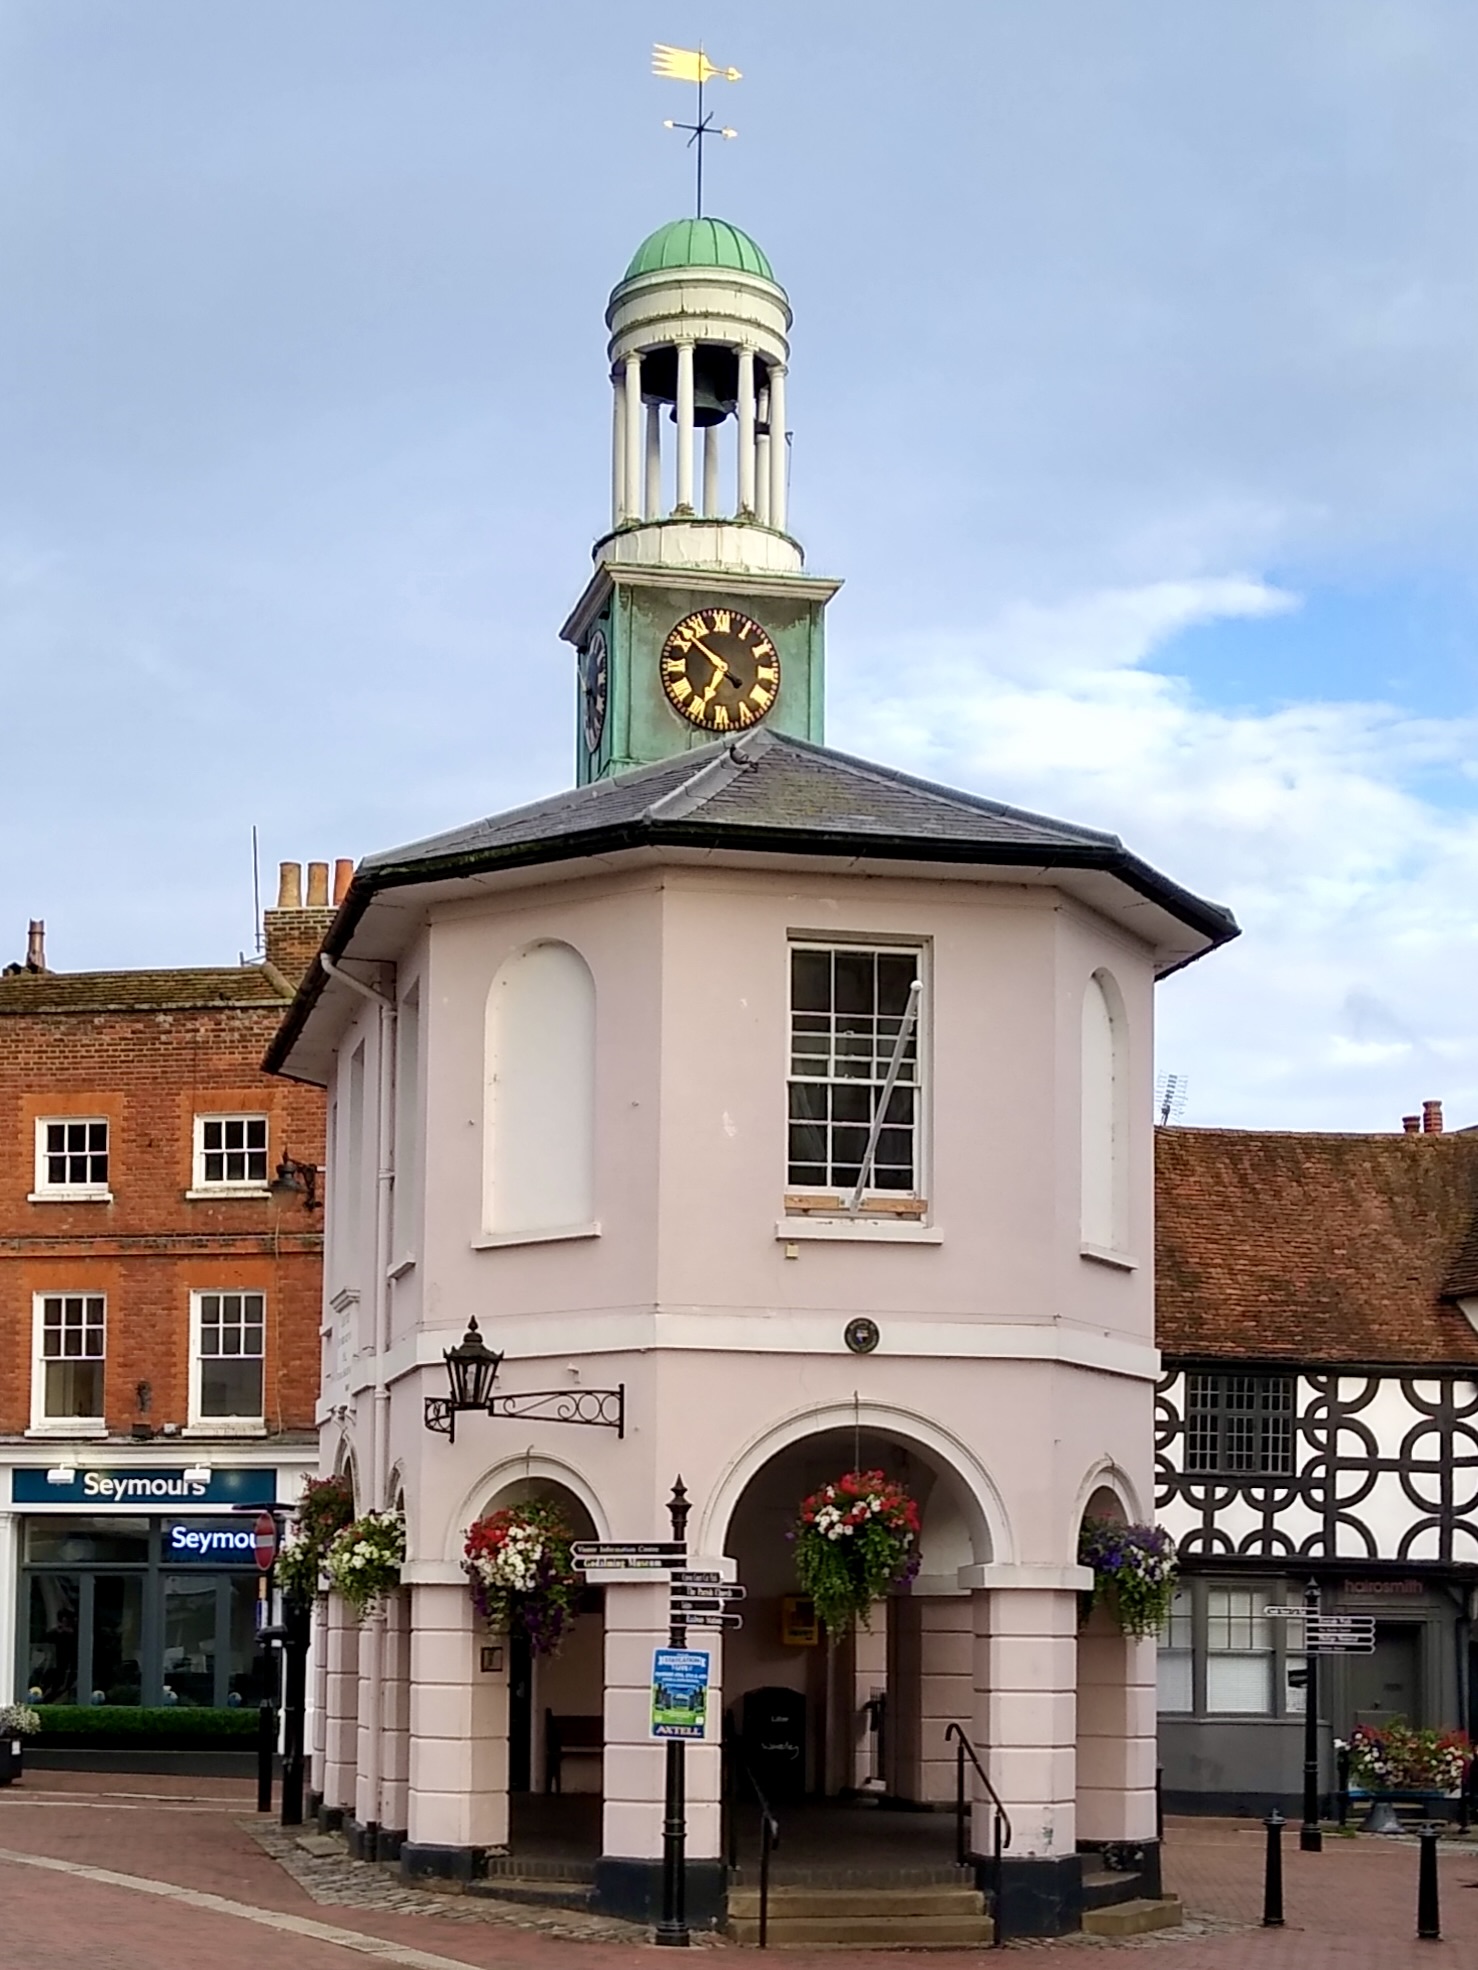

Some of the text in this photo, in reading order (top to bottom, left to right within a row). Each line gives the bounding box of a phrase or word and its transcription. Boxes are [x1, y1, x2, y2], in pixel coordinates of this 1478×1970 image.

[713, 612, 731, 633] XII
[738, 620, 752, 640] I
[714, 705, 730, 724] VI
[738, 701, 754, 719] V
[172, 1526, 256, 1554] Seymo
[583, 1558, 626, 1568] Godalming
[1344, 1579, 1423, 1593] hairosmith
[656, 1725, 702, 1736] AXTELL
